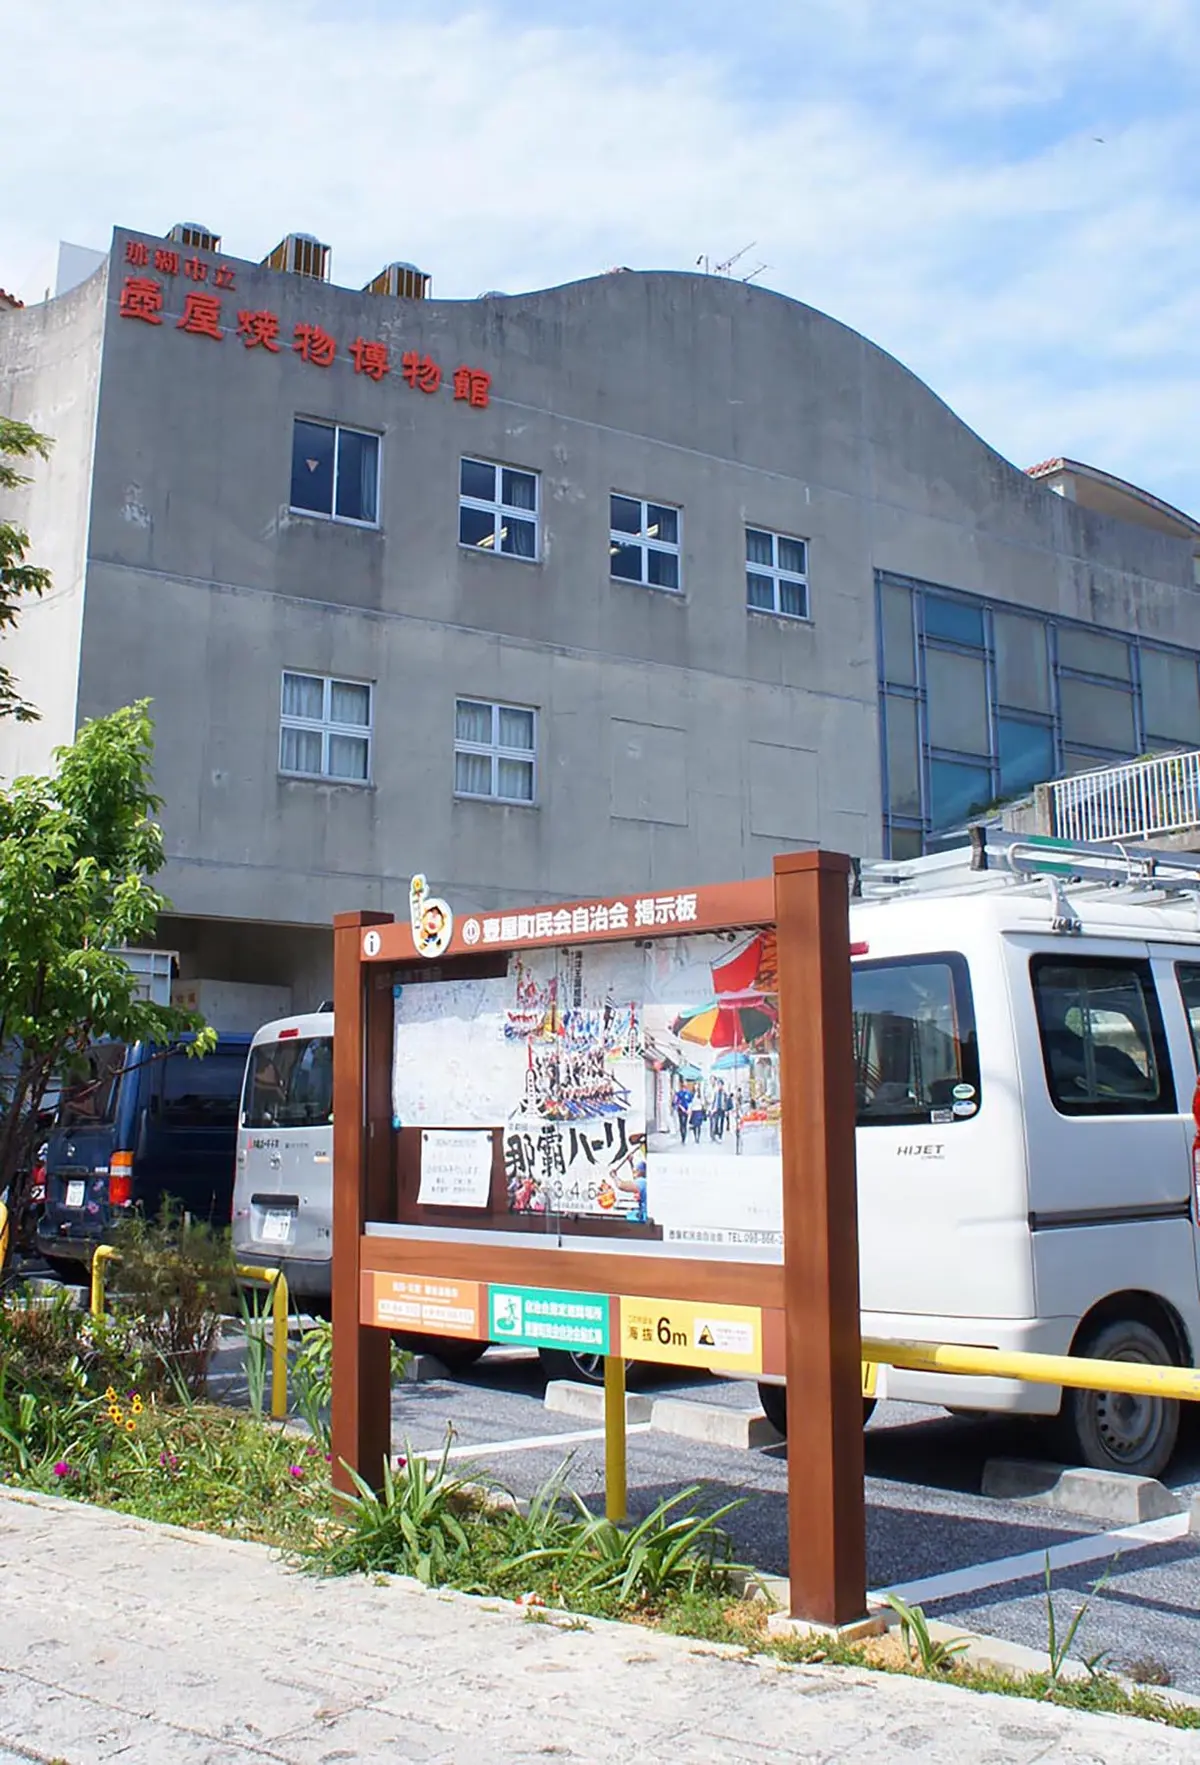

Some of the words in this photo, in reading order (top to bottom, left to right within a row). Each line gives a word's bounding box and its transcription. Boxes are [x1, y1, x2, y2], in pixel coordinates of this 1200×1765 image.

[634, 893, 698, 926] 掲示板
[896, 1144, 945, 1156] HIJET
[657, 1316, 687, 1346] 6m
